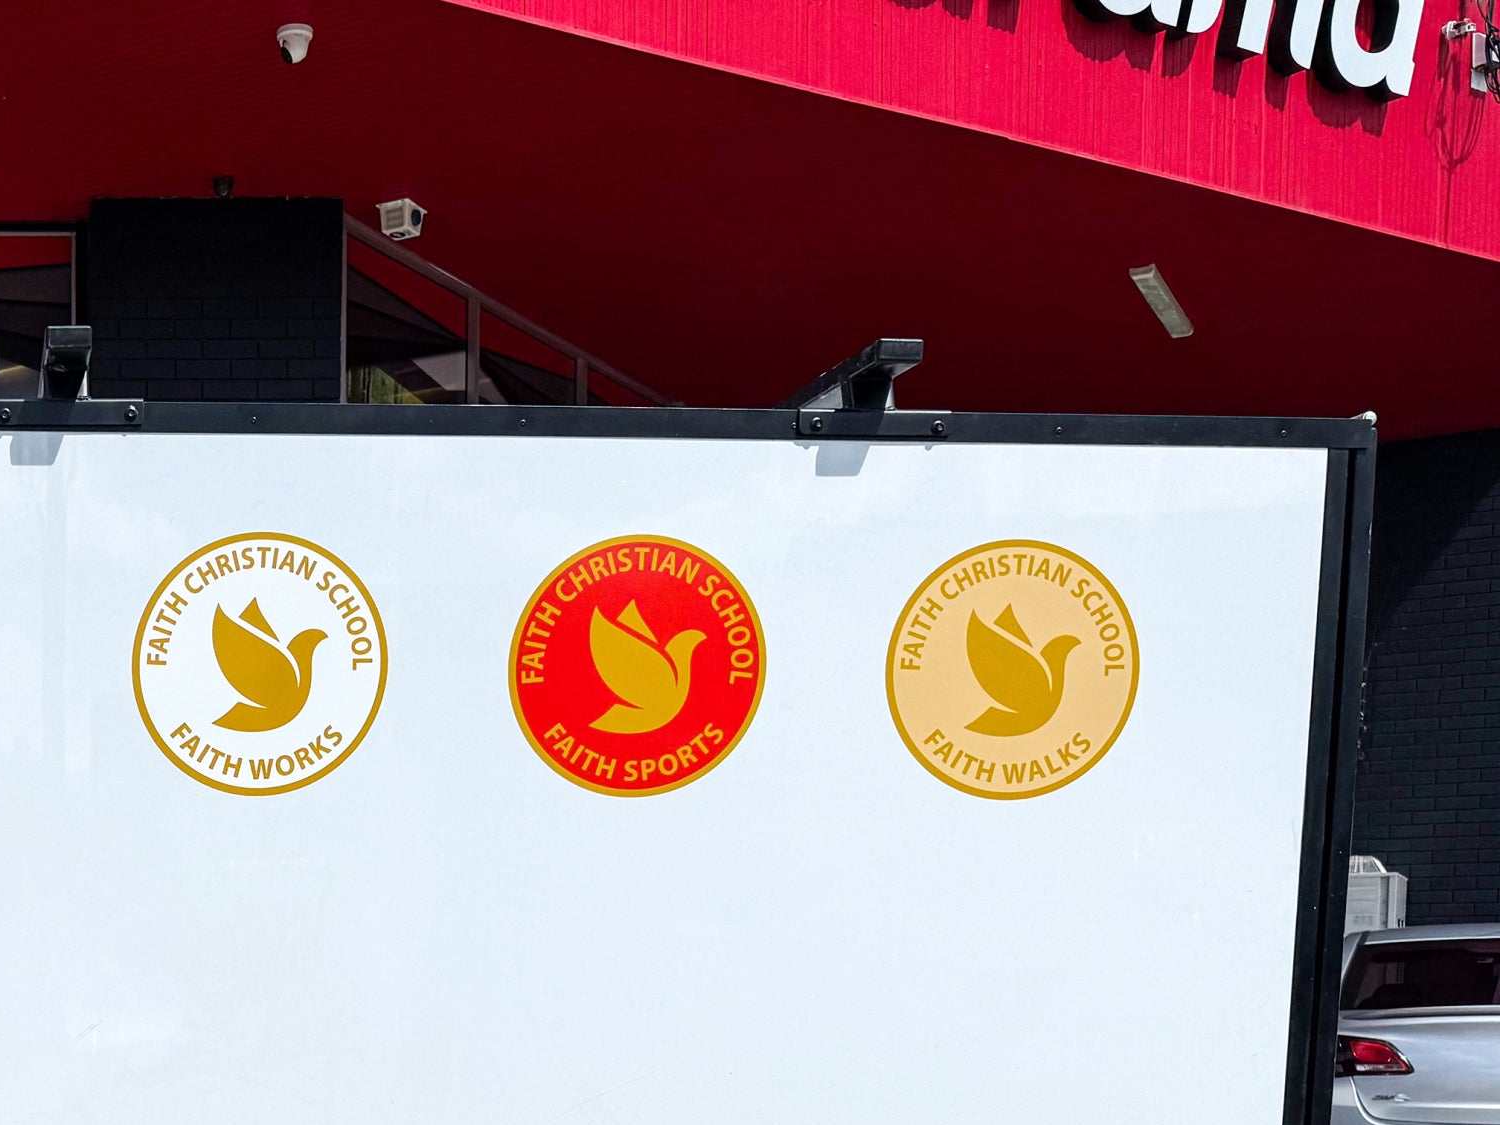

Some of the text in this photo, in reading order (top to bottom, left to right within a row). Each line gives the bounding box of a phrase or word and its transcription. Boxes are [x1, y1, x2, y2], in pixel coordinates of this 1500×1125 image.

[147, 547, 373, 671] FAITH CHRISTIAN SCHOOL
[521, 547, 754, 684] FAITH CHRISTIAN SCHOOL
[900, 554, 1125, 677] FAITH CHRISTIAN SCHOOL
[170, 722, 343, 779] FAITH WORKS
[543, 722, 724, 781] FAITH SPORTS
[923, 729, 1091, 784] FAITH WALKS
